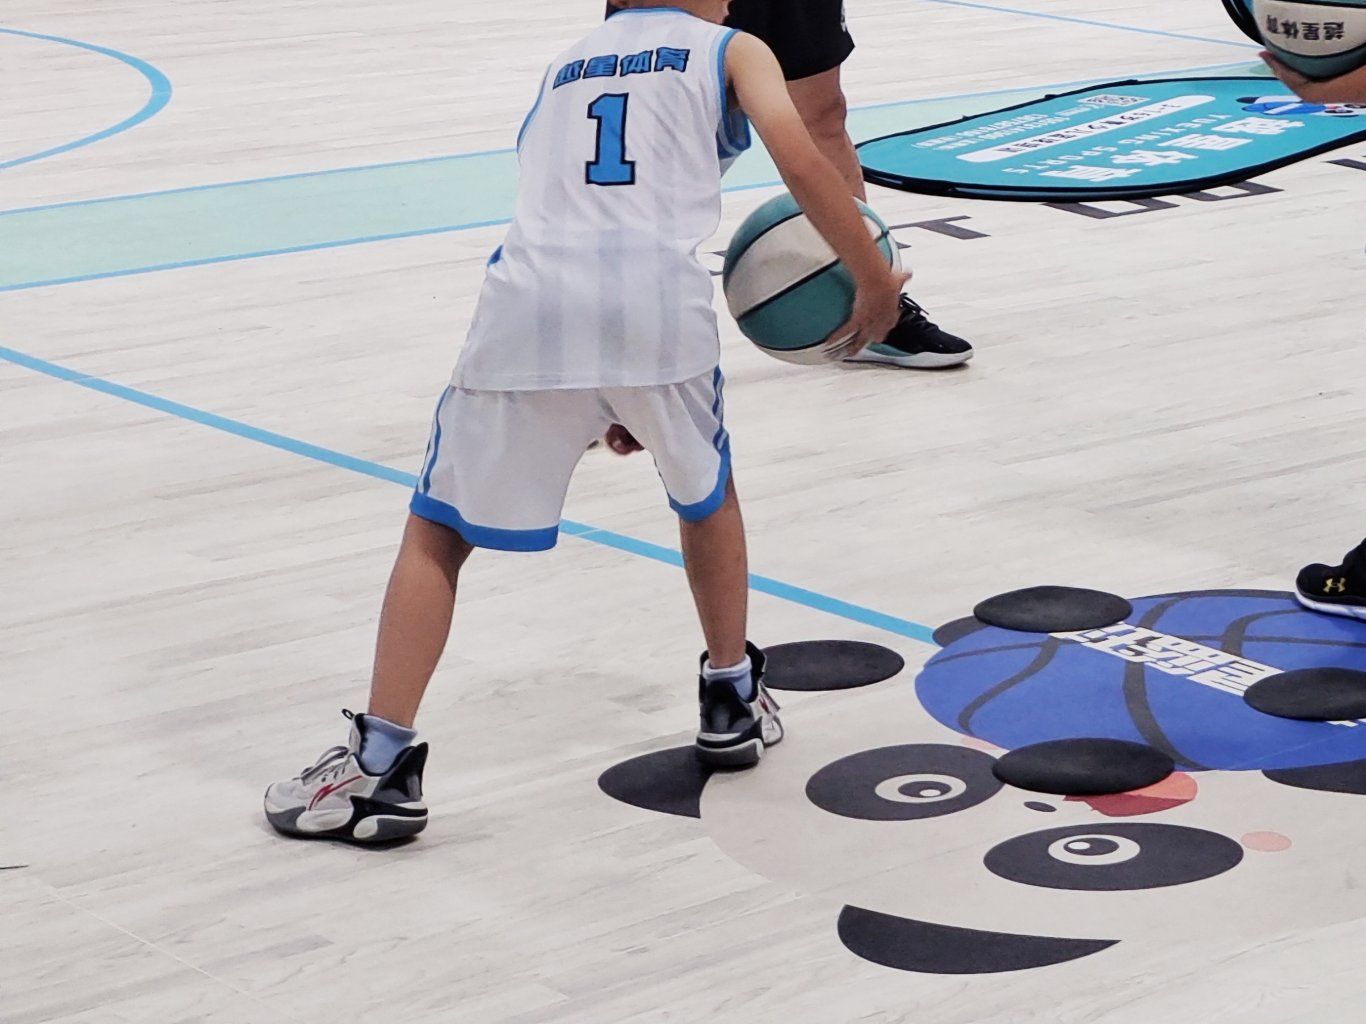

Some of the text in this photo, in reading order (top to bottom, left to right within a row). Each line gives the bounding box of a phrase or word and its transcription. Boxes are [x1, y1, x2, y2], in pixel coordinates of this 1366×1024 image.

[585, 92, 635, 186] 1
[1001, 145, 1118, 175] SPORTS
[1037, 116, 1306, 183] 越星体育
